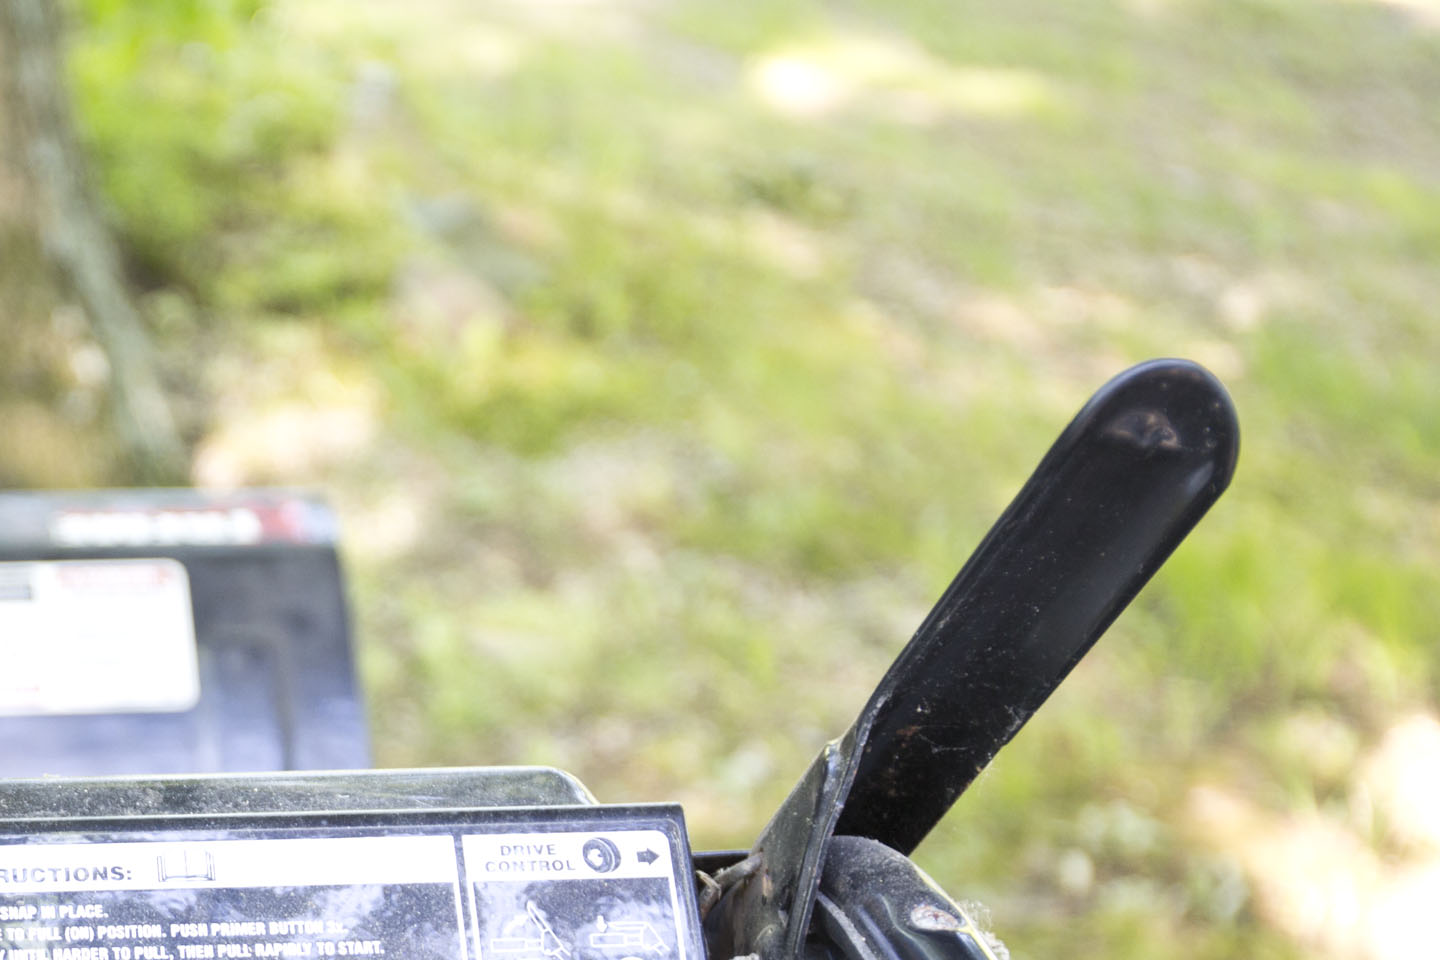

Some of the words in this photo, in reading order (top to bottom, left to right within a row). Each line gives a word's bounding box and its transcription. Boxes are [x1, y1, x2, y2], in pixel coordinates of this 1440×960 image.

[500, 844, 557, 856] DRIVE
[485, 859, 576, 873] CONTROL
[0, 905, 37, 920] SNAP
[40, 904, 56, 919] IN
[59, 904, 109, 919] PLACE.
[6, 927, 24, 942] TO
[28, 926, 62, 941] FULL
[65, 925, 94, 942] (ON)
[97, 924, 167, 940] POSITION.
[170, 923, 208, 937] PUSH
[211, 921, 266, 936] PRIMER
[269, 921, 323, 935] BUTTON
[112, 946, 131, 960] TO
[134, 945, 174, 960] PULL,
[177, 944, 214, 959] THEN
[217, 943, 251, 958] PULL
[255, 942, 312, 957] RAPIDLY
[316, 941, 335, 956] TO
[337, 940, 385, 955] START.
